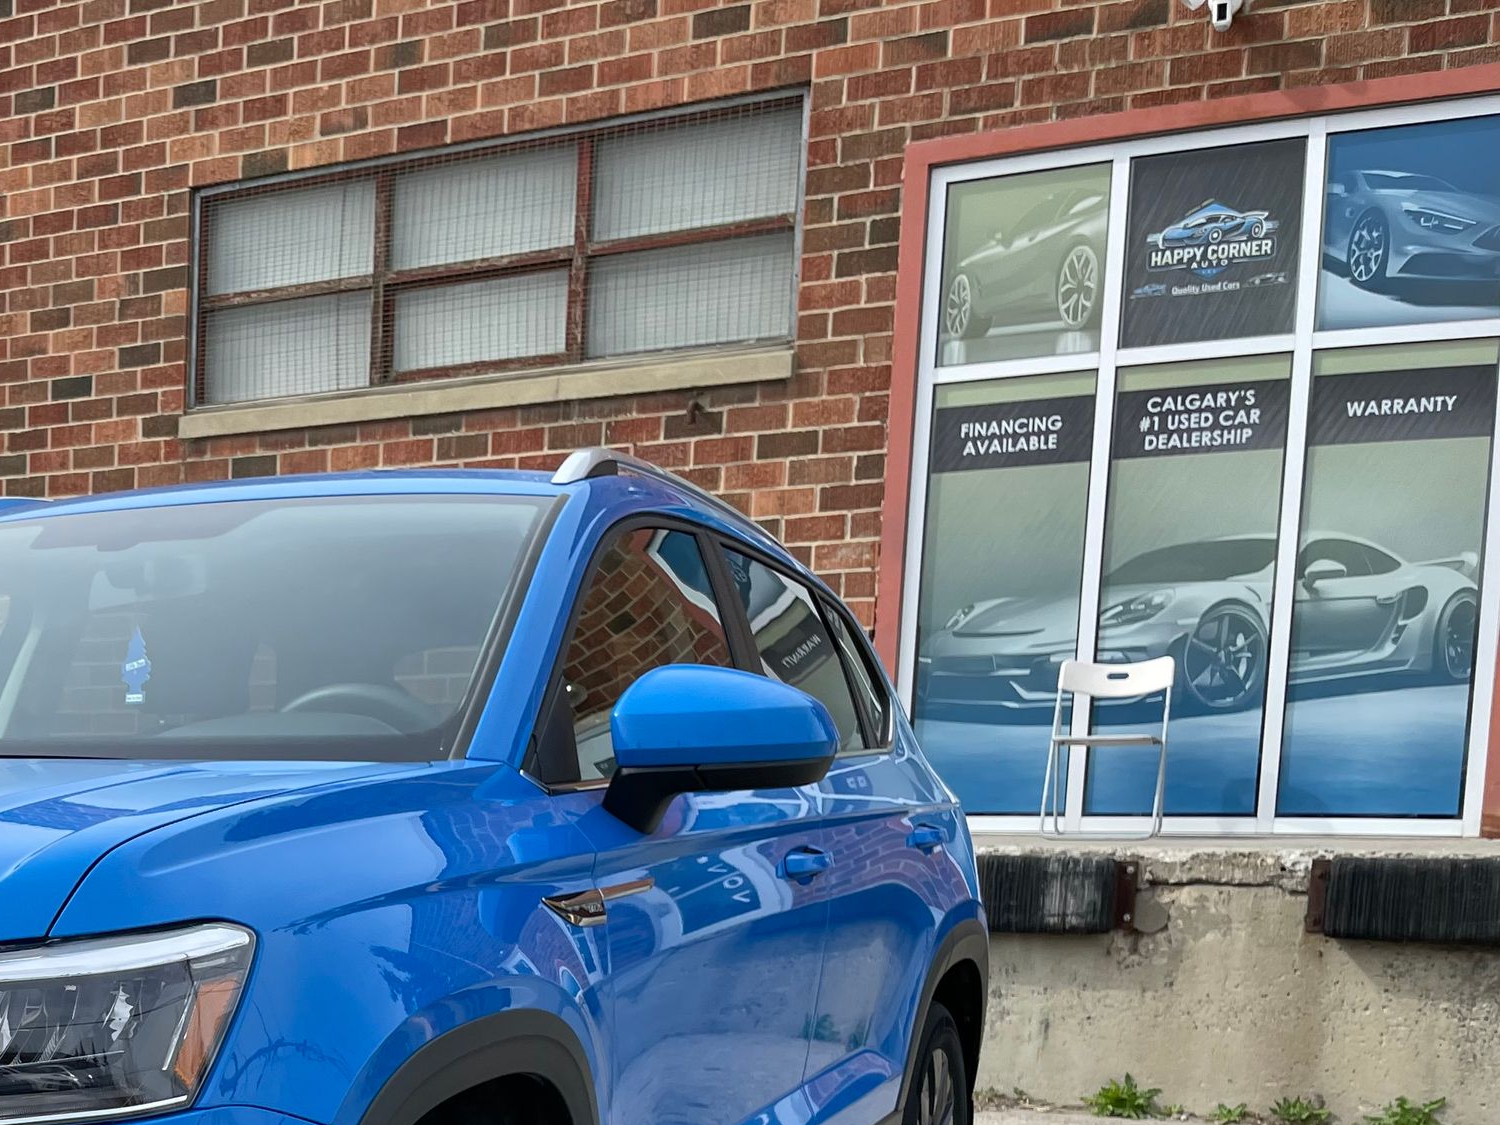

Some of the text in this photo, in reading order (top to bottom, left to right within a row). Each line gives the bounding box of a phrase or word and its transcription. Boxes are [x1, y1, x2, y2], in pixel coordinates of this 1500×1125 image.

[1151, 240, 1272, 267] HAPPY CORNER
[1191, 259, 1228, 269] AUTO
[1172, 281, 1240, 295] Quality Used Cars
[1147, 389, 1256, 413] CALGARY'S
[1346, 395, 1457, 417] WARRANTY
[960, 415, 1062, 439] FINANCING
[1139, 408, 1260, 432] #1 USED CAR
[962, 434, 1058, 456] AVAILABLE
[1144, 428, 1252, 450] DEALERSHIP
